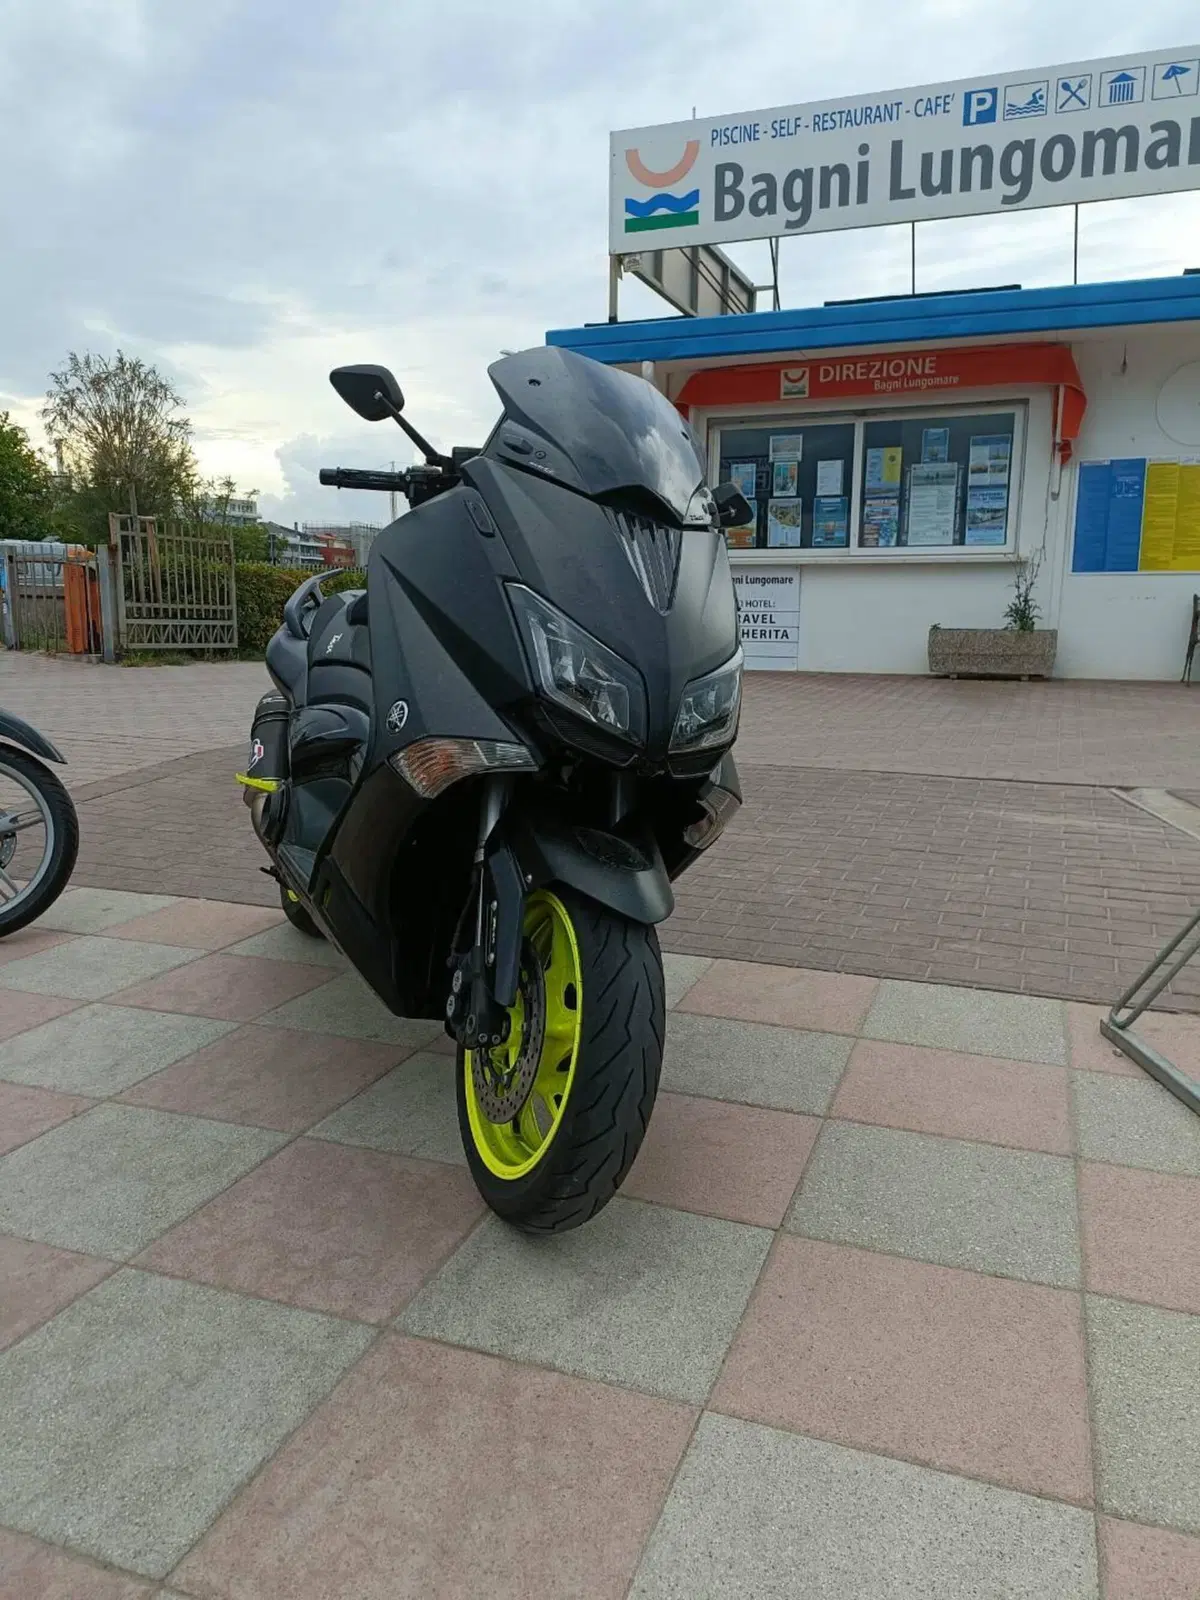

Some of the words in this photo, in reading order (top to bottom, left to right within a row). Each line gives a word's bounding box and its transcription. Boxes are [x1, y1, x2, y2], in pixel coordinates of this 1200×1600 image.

[711, 123, 760, 147] PISCINE
[771, 117, 801, 139] SELF
[813, 102, 903, 133] RESTAURANT
[714, 143, 870, 230] Bagni
[819, 357, 937, 383] DIREZIONE
[874, 379, 901, 392] Bagni
[904, 375, 960, 390] Lungomare
[745, 575, 794, 587] Lungomare
[745, 600, 776, 608] HOTEL:
[741, 628, 790, 640] HERITA
